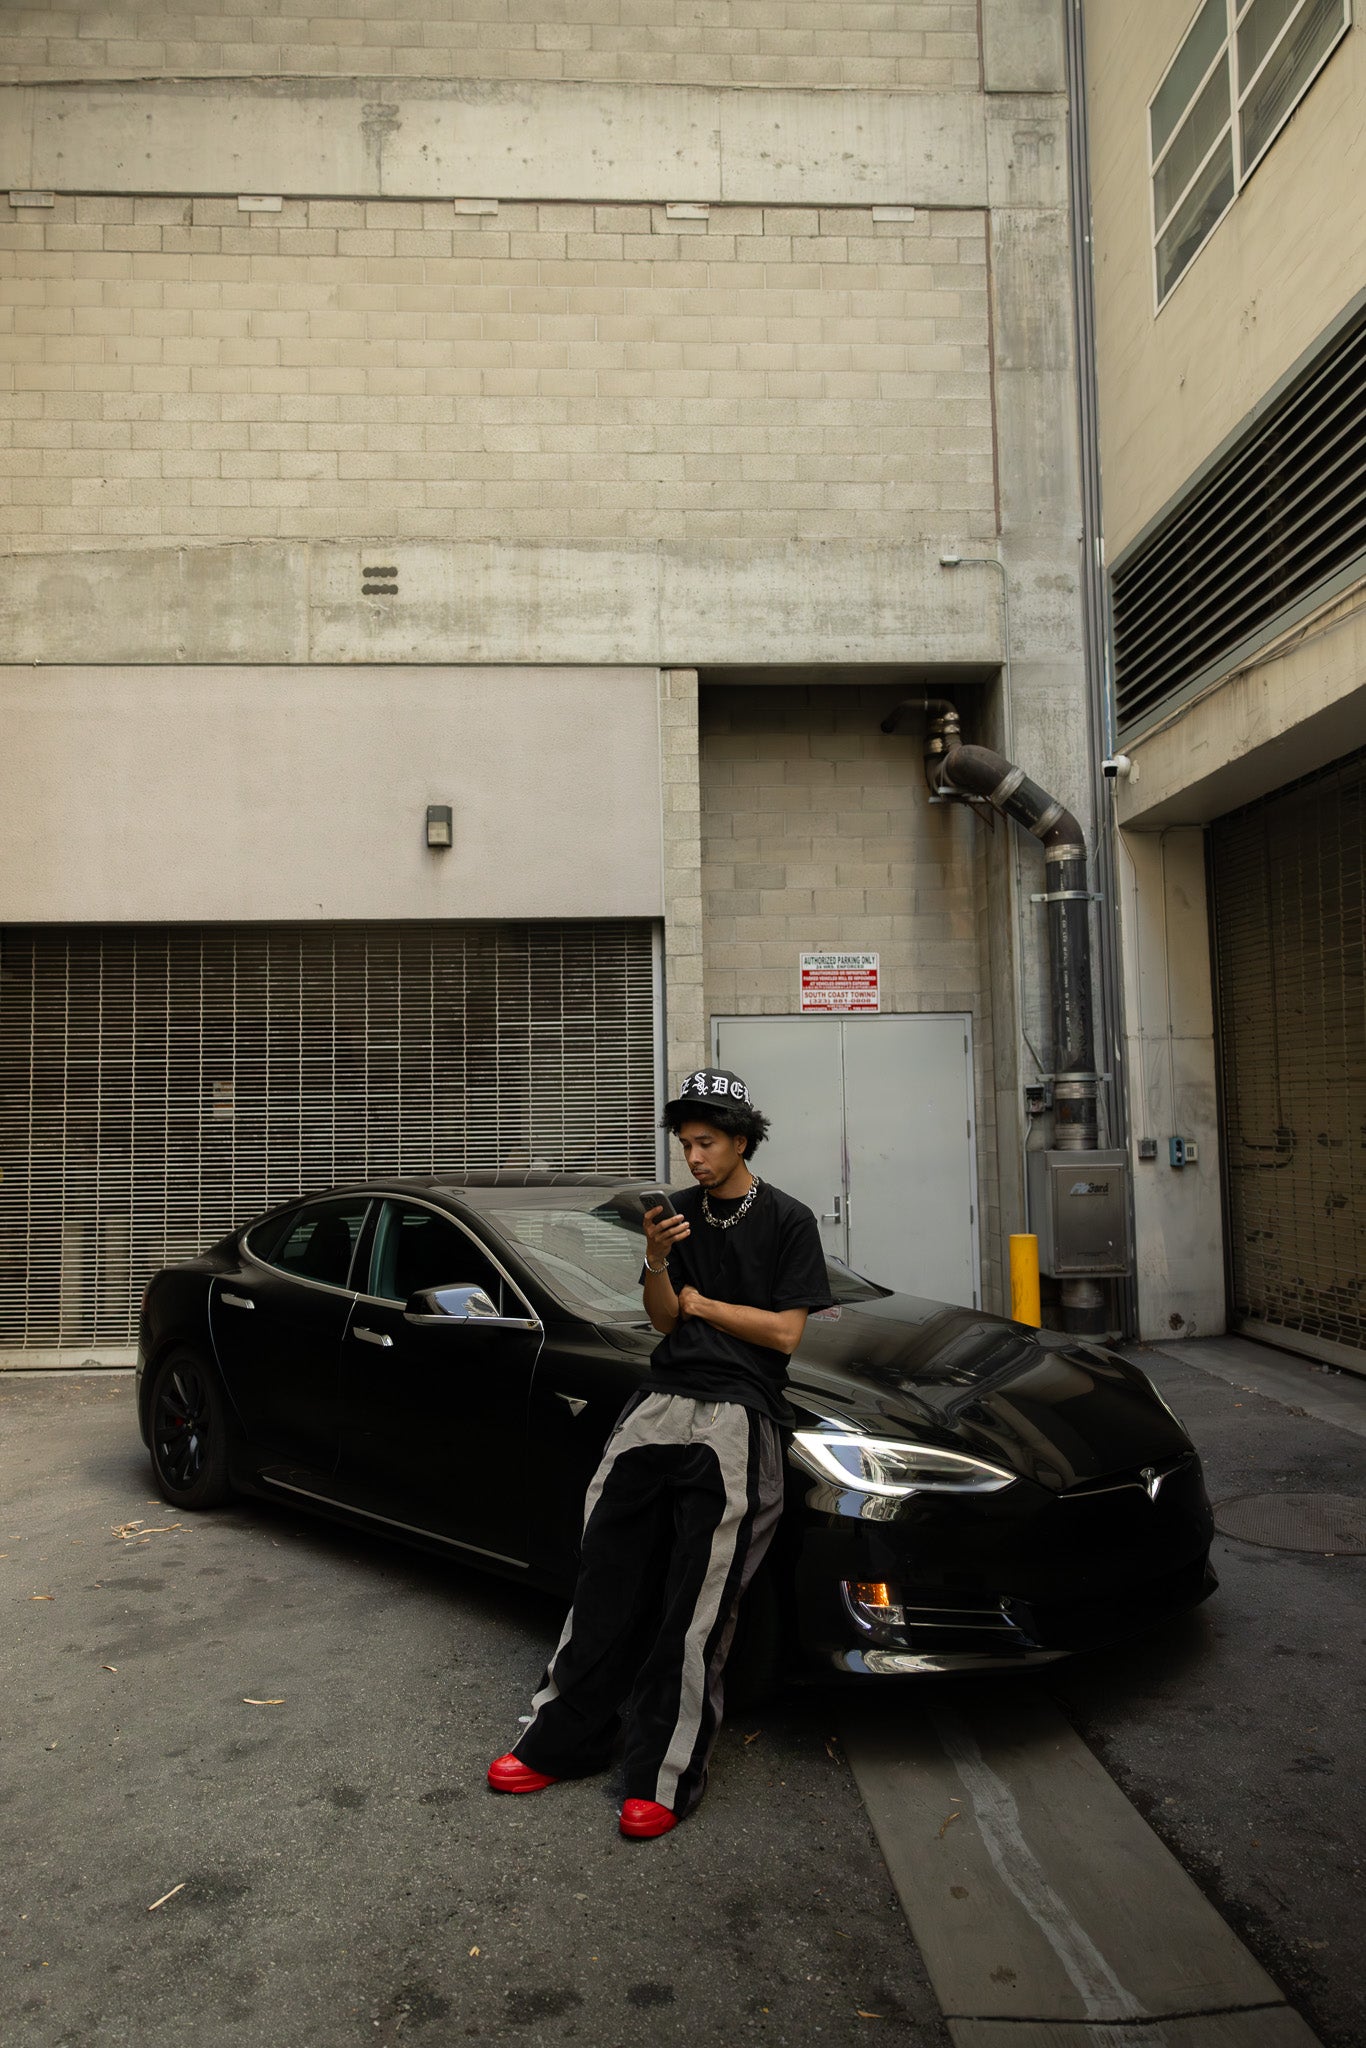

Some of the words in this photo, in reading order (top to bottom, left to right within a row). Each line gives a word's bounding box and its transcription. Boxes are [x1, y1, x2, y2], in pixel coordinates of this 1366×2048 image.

[804, 956, 836, 964] AUTHORIZED
[838, 956, 860, 964] PARKING
[862, 956, 875, 964] ONLY
